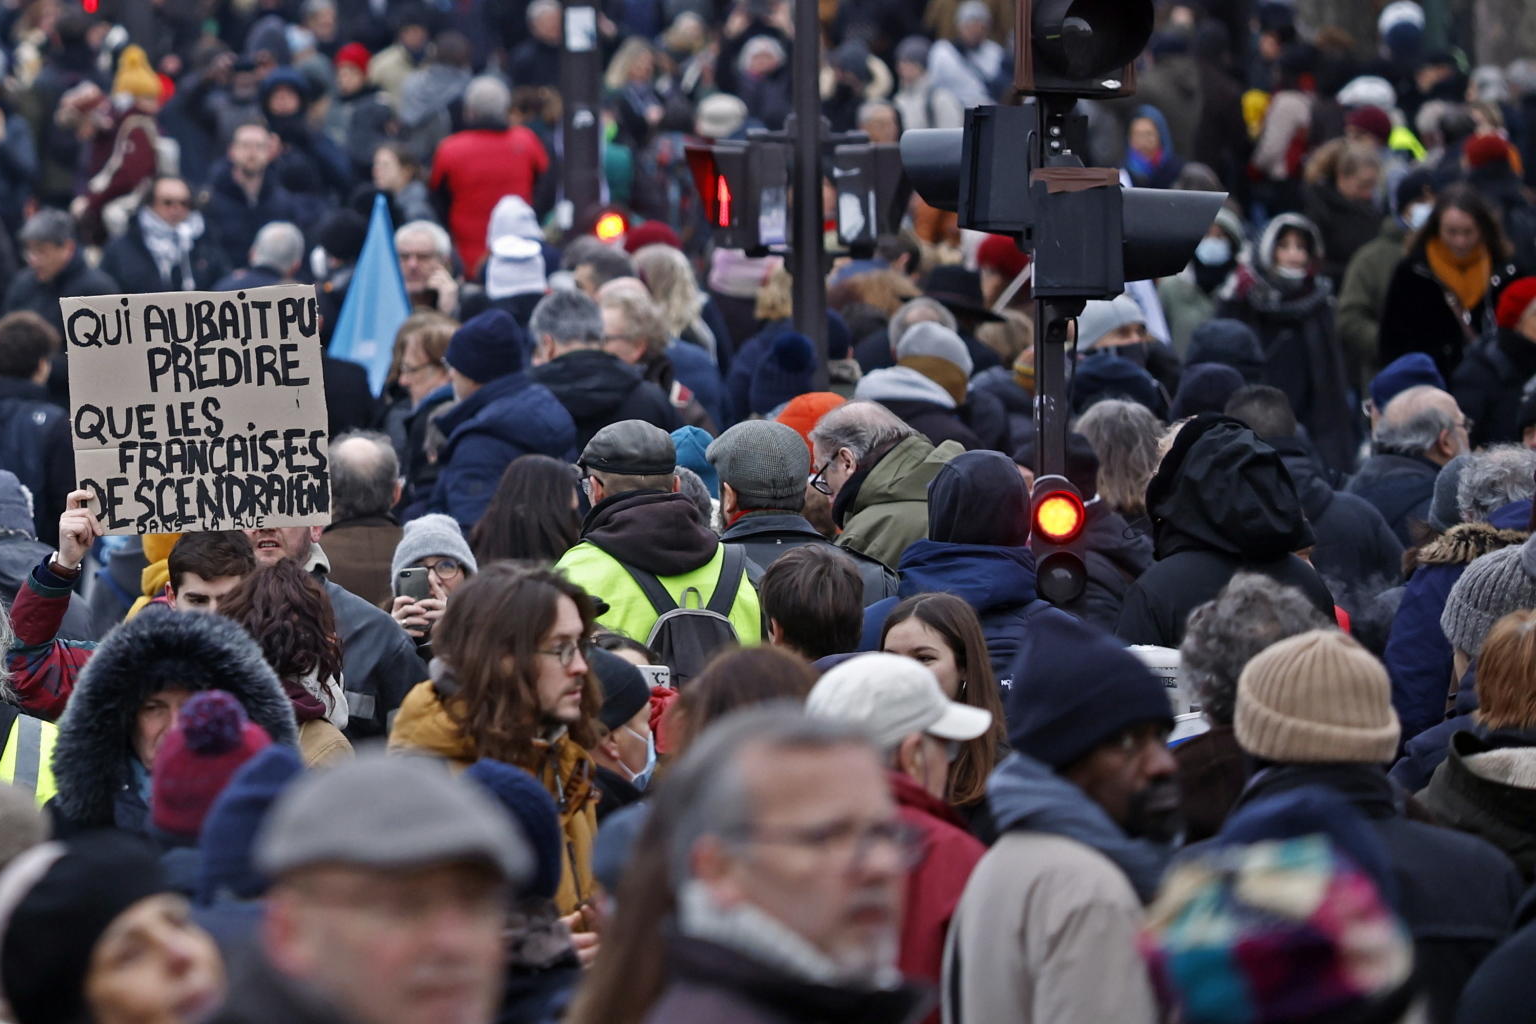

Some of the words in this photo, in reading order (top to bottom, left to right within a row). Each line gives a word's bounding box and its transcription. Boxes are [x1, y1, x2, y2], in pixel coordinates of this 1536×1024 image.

[277, 297, 317, 340] PU
[74, 403, 157, 445] QUE
[166, 397, 224, 438] LES
[136, 517, 183, 534] DANS
[202, 516, 220, 531] LA
[233, 516, 265, 529] RUE
